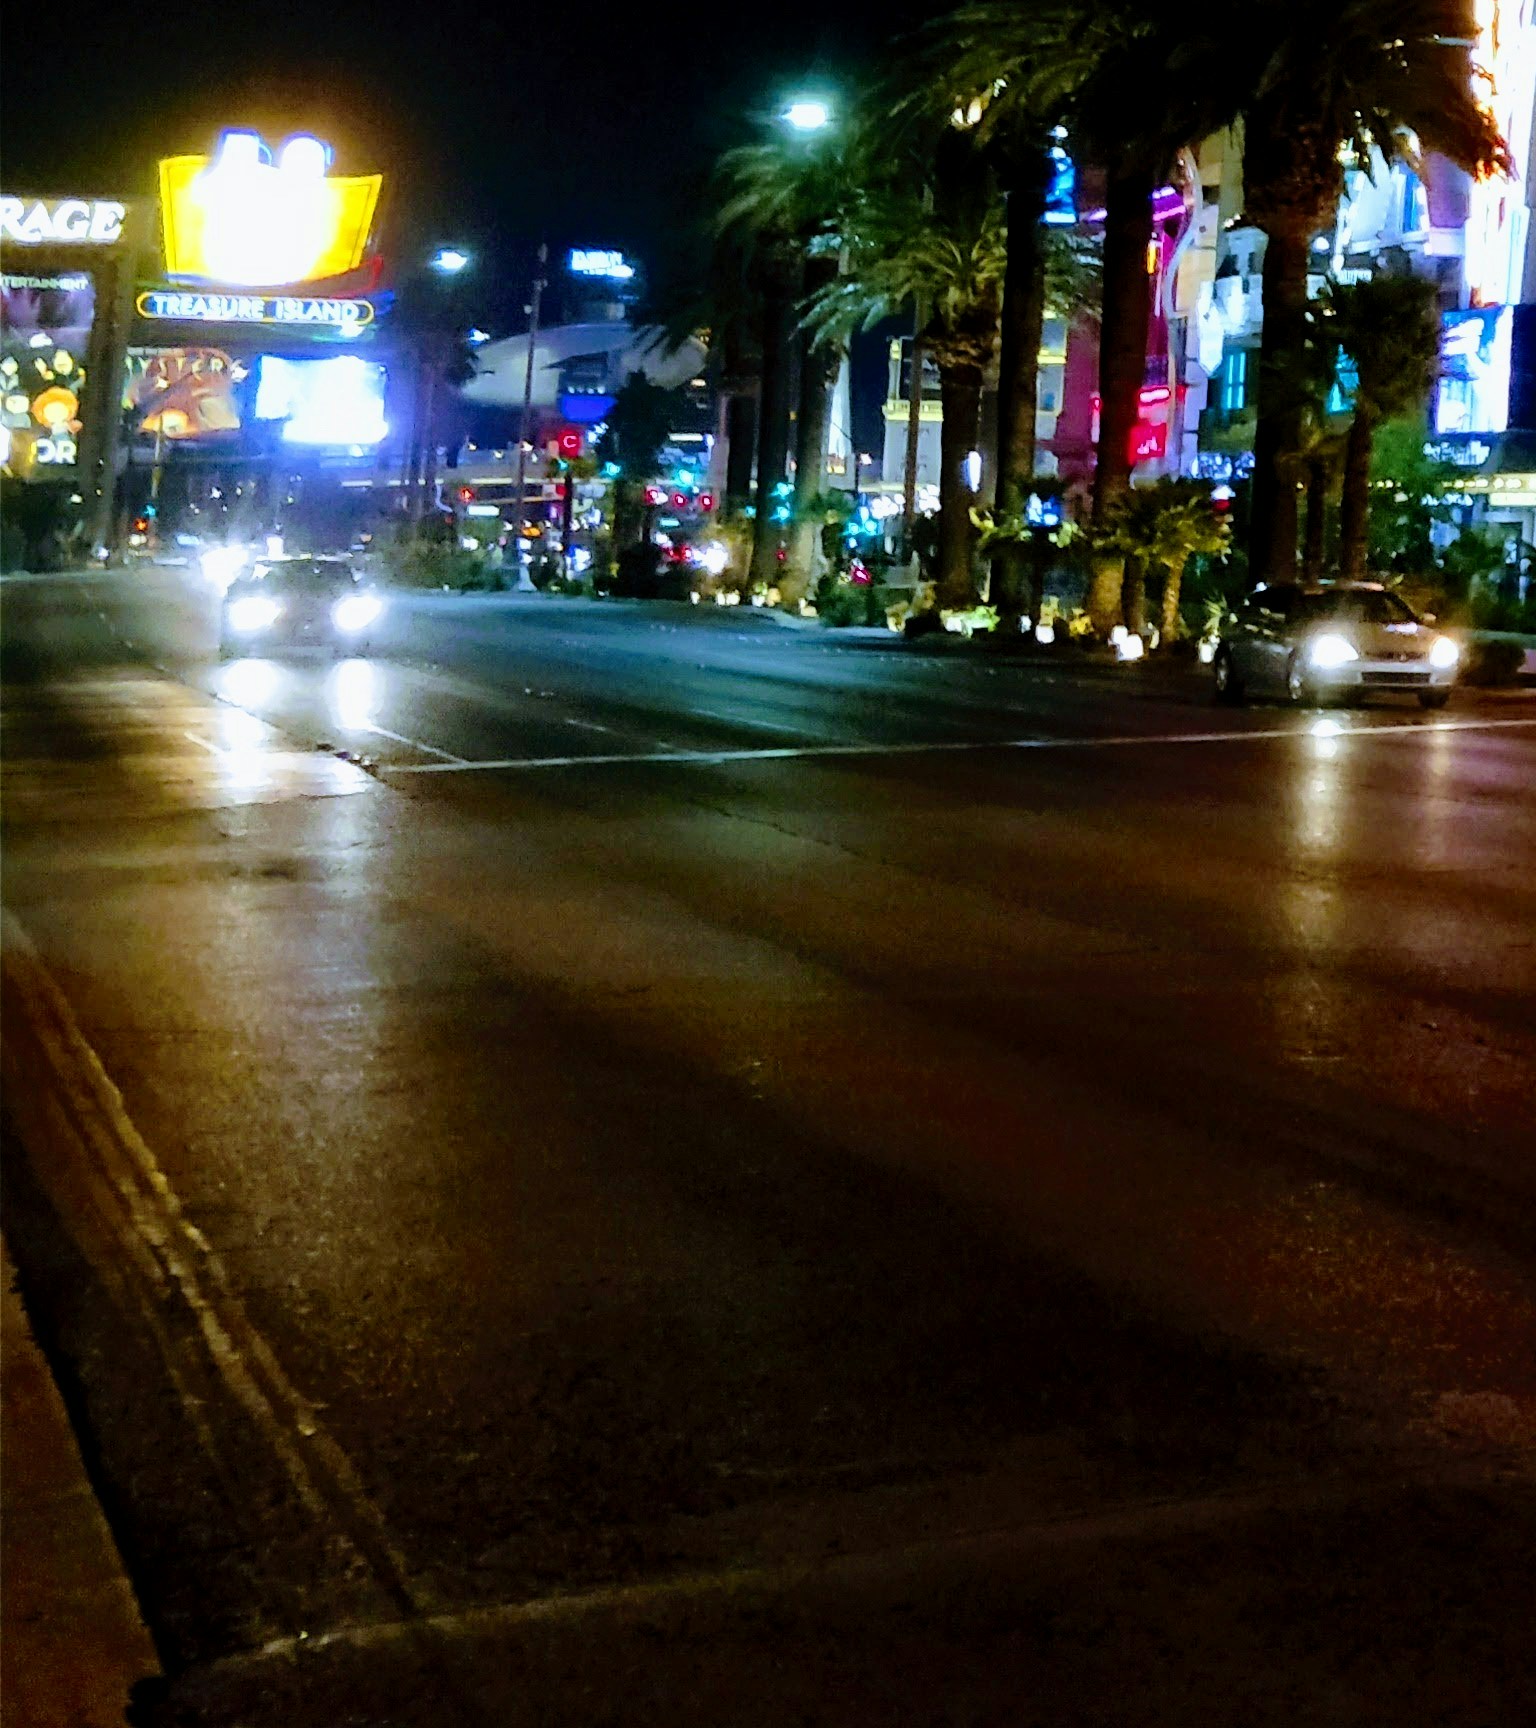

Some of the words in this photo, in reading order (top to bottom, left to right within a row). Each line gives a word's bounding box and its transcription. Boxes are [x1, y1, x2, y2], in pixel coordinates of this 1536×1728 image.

[0, 196, 125, 244] RAGE
[154, 295, 265, 319] TREASURE
[275, 300, 359, 322] ISLAND
